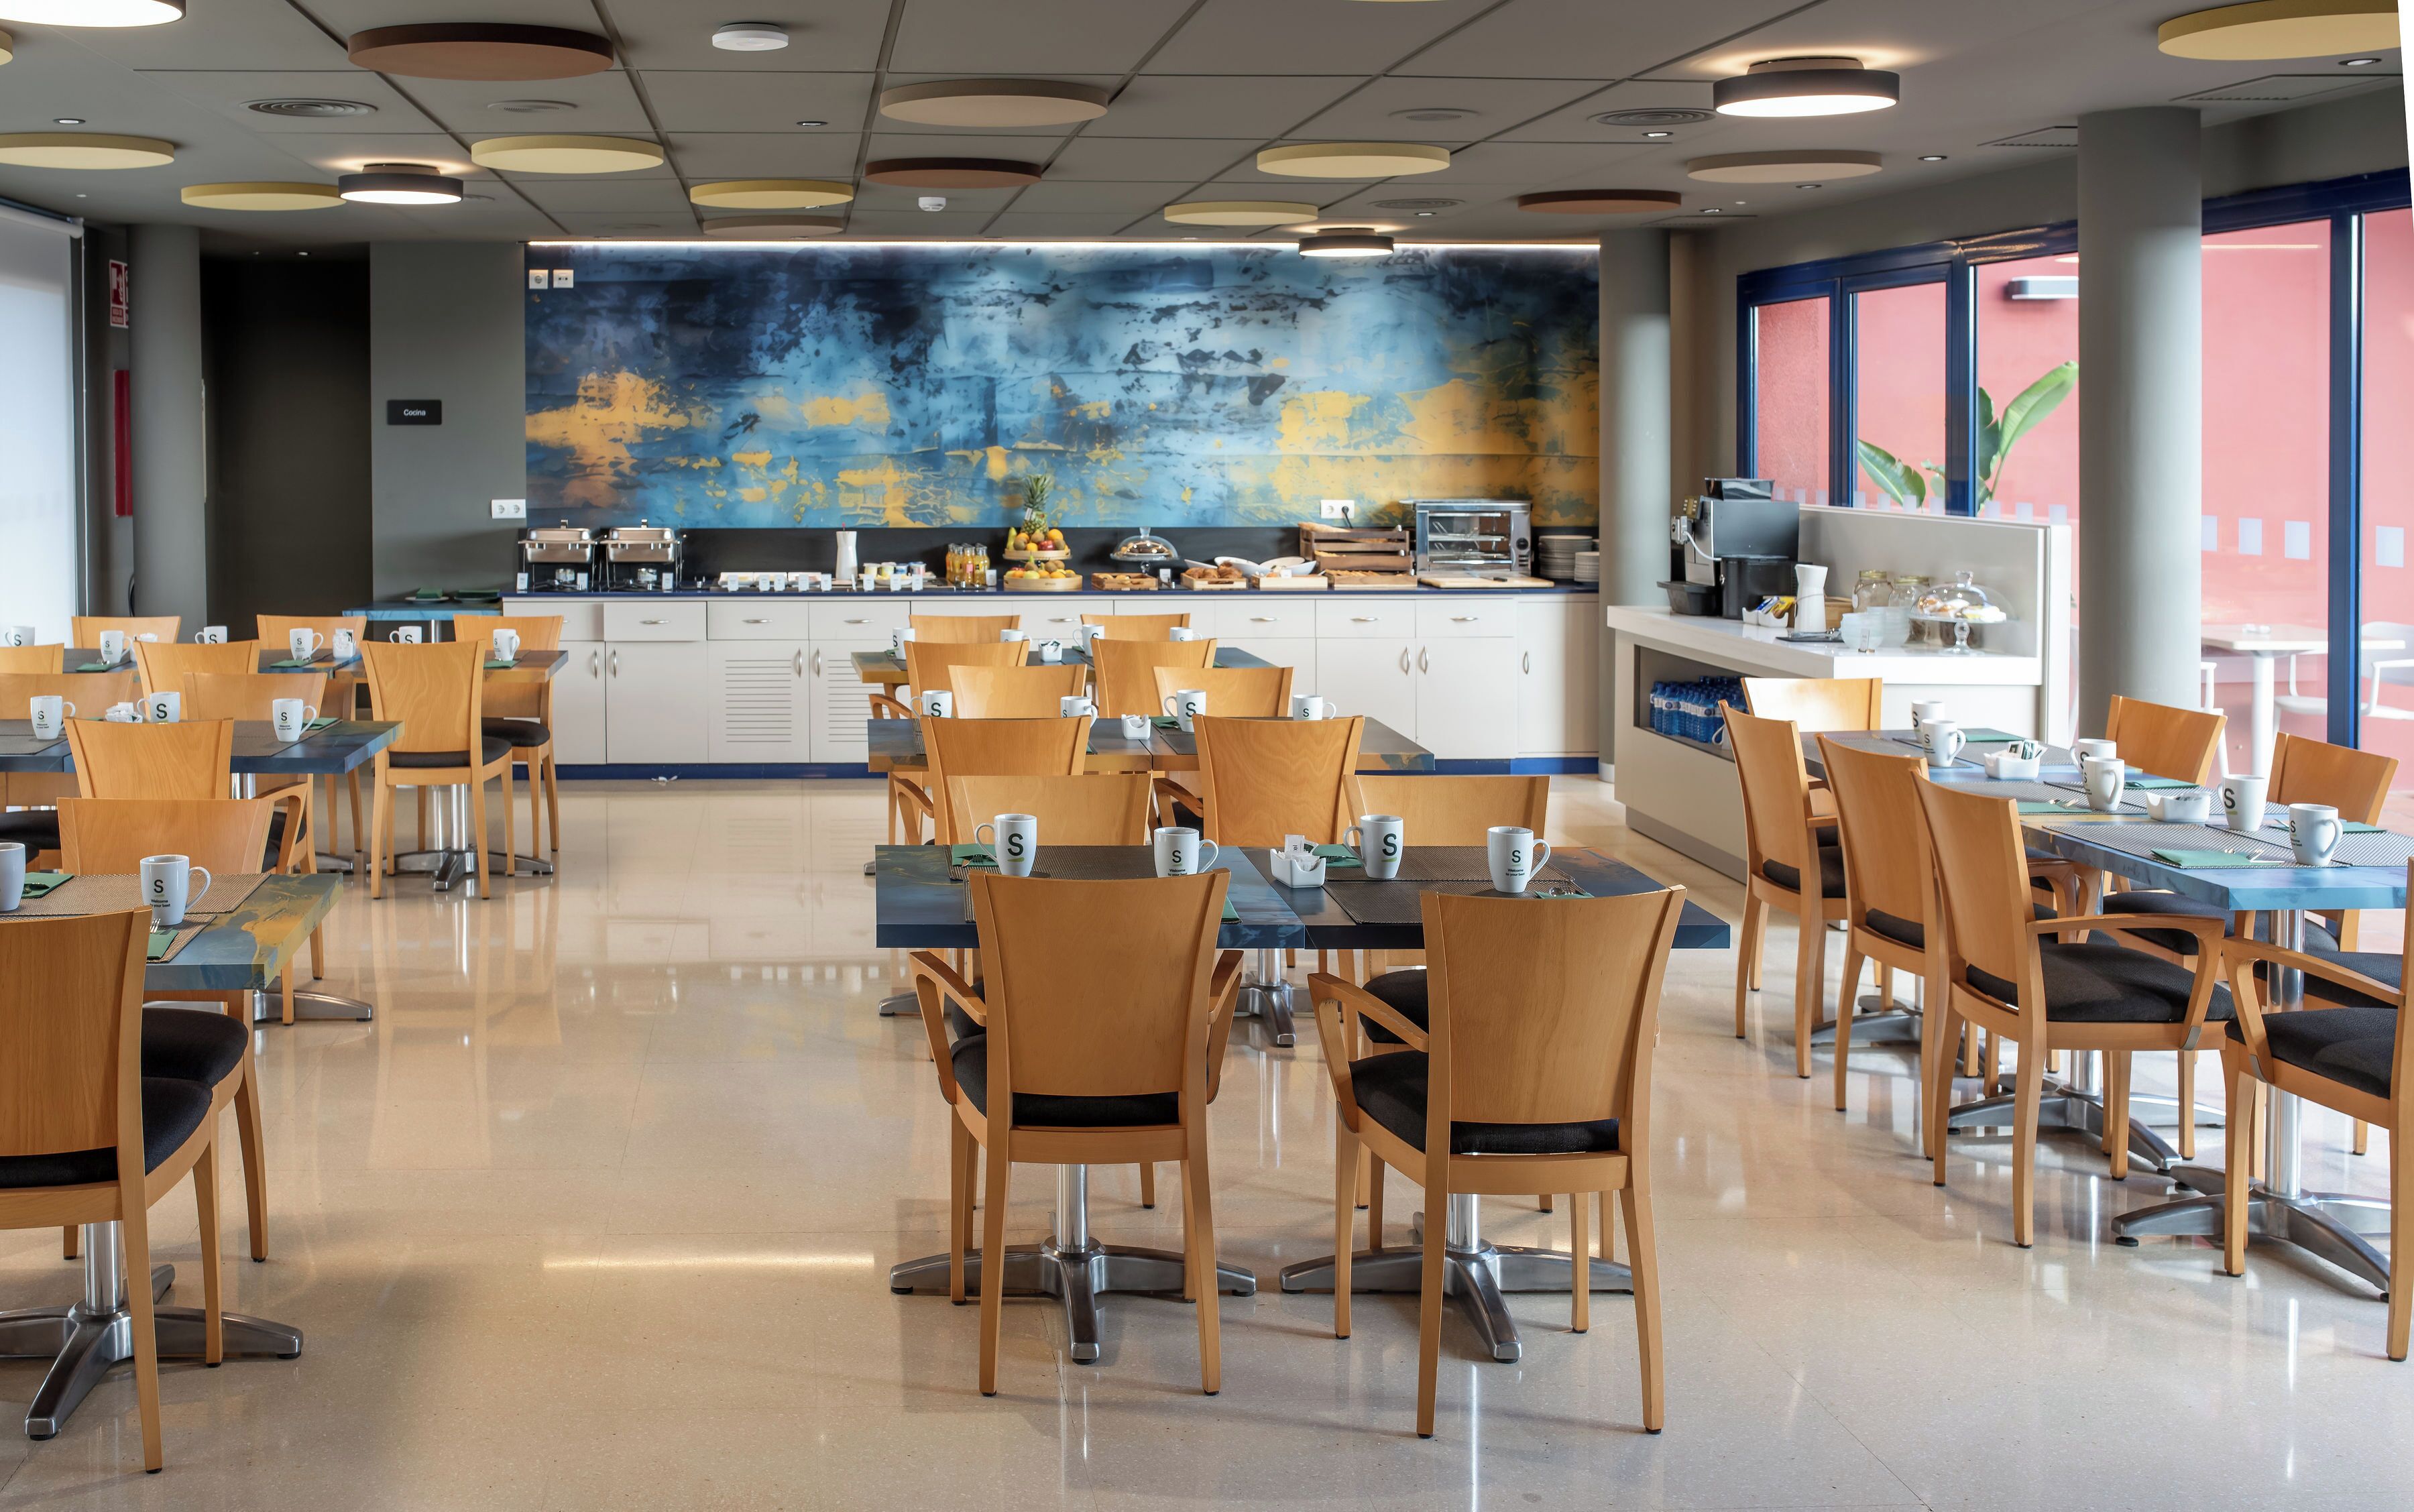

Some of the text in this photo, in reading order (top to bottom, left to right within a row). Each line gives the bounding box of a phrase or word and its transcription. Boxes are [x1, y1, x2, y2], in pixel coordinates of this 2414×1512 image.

[15, 634, 21, 646] S
[893, 636, 898, 647] S
[38, 711, 44, 719] S
[156, 703, 168, 719] S
[931, 703, 941, 717] S
[1063, 709, 1068, 717] S
[1186, 702, 1196, 717] S
[1303, 708, 1310, 717] S
[281, 712, 288, 721] S
[1912, 711, 1918, 728] S
[1924, 734, 1931, 744] S
[2224, 788, 2236, 809] S
[2291, 820, 2296, 833] S
[1007, 833, 1024, 856] S
[1382, 833, 1397, 856] S
[1172, 850, 1182, 863] S
[1511, 850, 1521, 863] S
[154, 880, 164, 893] S
